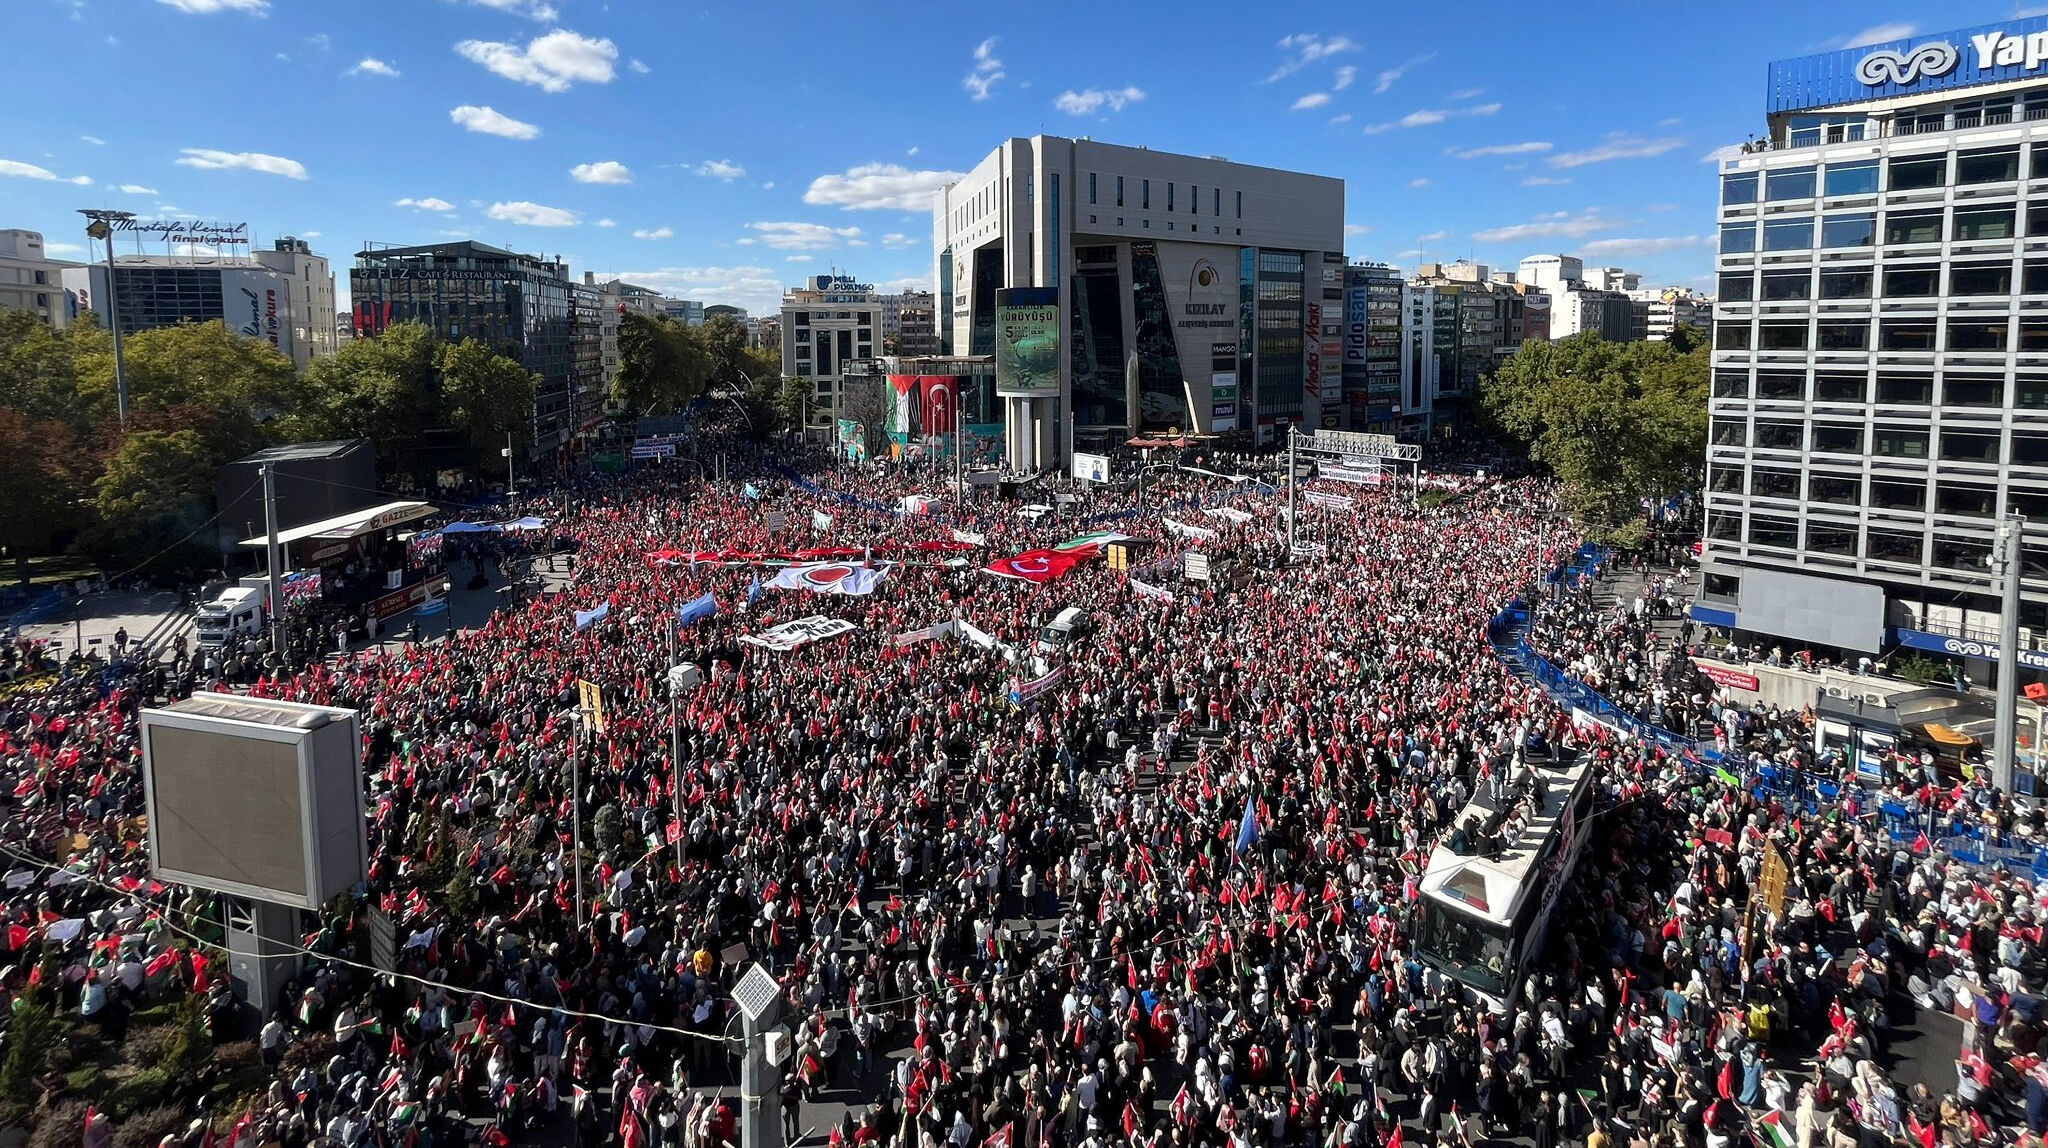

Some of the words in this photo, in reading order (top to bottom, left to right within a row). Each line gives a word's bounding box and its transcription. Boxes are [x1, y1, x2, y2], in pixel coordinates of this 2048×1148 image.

[112, 219, 188, 241] Mustafa
[191, 220, 247, 233] Kemal
[172, 235, 203, 243] final
[378, 269, 410, 279] FLZ
[266, 289, 277, 318] kurs
[1185, 303, 1226, 315] KIZILAY
[241, 288, 260, 336] Kemal
[1000, 311, 1053, 323] YÜRÜYÜŞÜ
[1305, 302, 1320, 343] Markt
[1347, 289, 1365, 360] Pidosan
[1006, 325, 1013, 338] 5
[1305, 353, 1319, 398] Media
[1215, 404, 1233, 414] mavi
[382, 510, 409, 524] GAZZE
